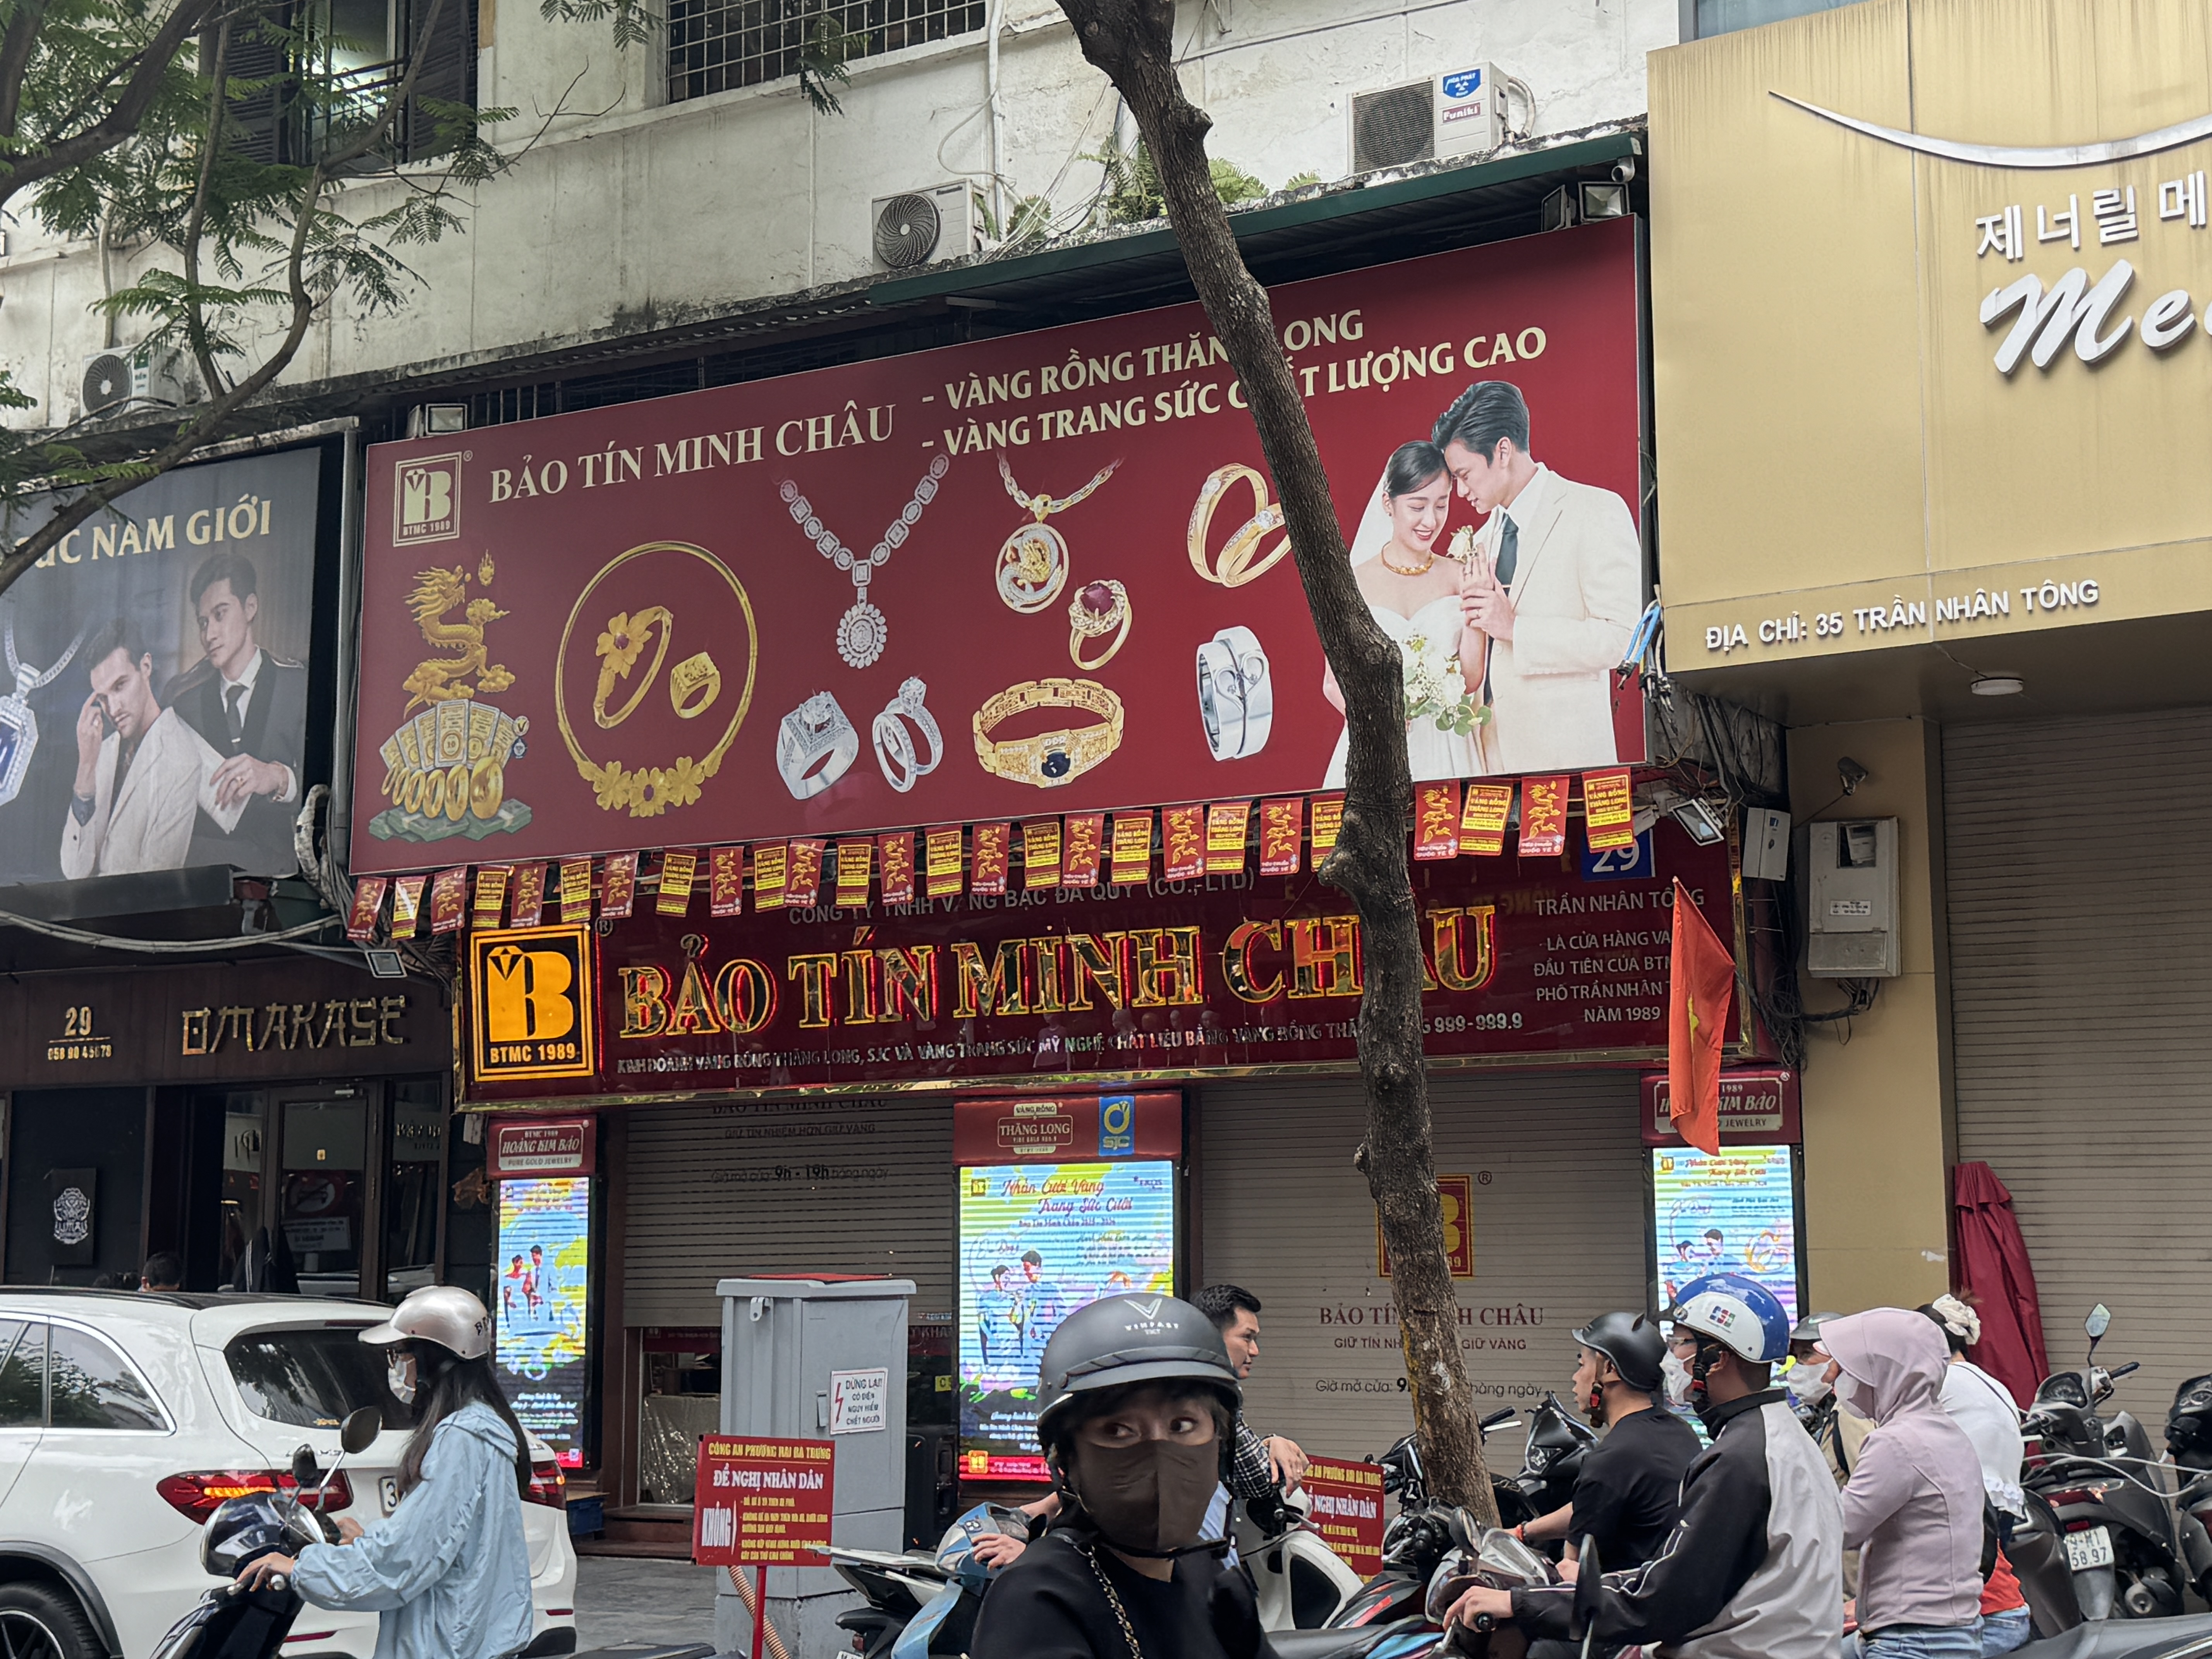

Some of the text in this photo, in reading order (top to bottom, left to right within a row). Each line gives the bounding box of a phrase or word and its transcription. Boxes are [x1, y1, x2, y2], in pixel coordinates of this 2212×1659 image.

[1443, 105, 1478, 121] Funiki
[1979, 259, 2212, 375] Me
[945, 309, 1364, 411] VÀNG RỒNG THĂN ONG
[944, 420, 1031, 456] VÀNG
[1038, 399, 1147, 451] TRANG
[1154, 380, 1221, 422] SỨC
[1328, 345, 1454, 394] LƯỢNG
[1464, 327, 1546, 368] CAO
[489, 400, 896, 503] BẢO TÍN MINH CHÂU
[91, 493, 271, 560] NAM GIỚI
[1705, 578, 2099, 653] ĐỊA CHỈ: 35 TRẦN NHÂN TÔNG
[1535, 892, 1585, 915] TRẦN
[1590, 890, 1644, 912] NHÂN
[1649, 887, 1704, 908] TÔG
[1547, 930, 1649, 951] LÀ CỬA HÀNG
[618, 905, 1495, 1039] BẢO TÍN MINH CHU
[1570, 957, 1603, 974] TIÊN
[1607, 954, 1639, 972] CỦA
[1570, 980, 1614, 999] TRẦN
[1616, 979, 1662, 996] NHÂN
[64, 1006, 92, 1036] 29
[182, 994, 406, 1056] OMAKASE
[1584, 1006, 1660, 1022] NĂM 1989
[895, 1042, 914, 1061] VÀ
[918, 1041, 955, 1059] VÀNG
[1325, 1018, 1358, 1039] THĂ
[490, 1042, 576, 1064] BTMC 1989
[1721, 1084, 1743, 1093] 1989
[1744, 1090, 1777, 1111] BẢO
[1000, 1123, 1070, 1136] THĂNG LONG
[502, 1135, 580, 1154] HOÀNG KIM BẢO
[775, 1164, 791, 1180] 9h
[806, 1164, 829, 1180] 19h
[1320, 1302, 1364, 1325] BẢO
[1480, 1303, 1544, 1325] CHÂU
[1360, 1336, 1381, 1348] TÍN
[1489, 1337, 1527, 1350] VÀNG
[732, 1470, 761, 1492] NGHỊ
[763, 1468, 796, 1489] NHÂN
[798, 1468, 824, 1489] DÂN
